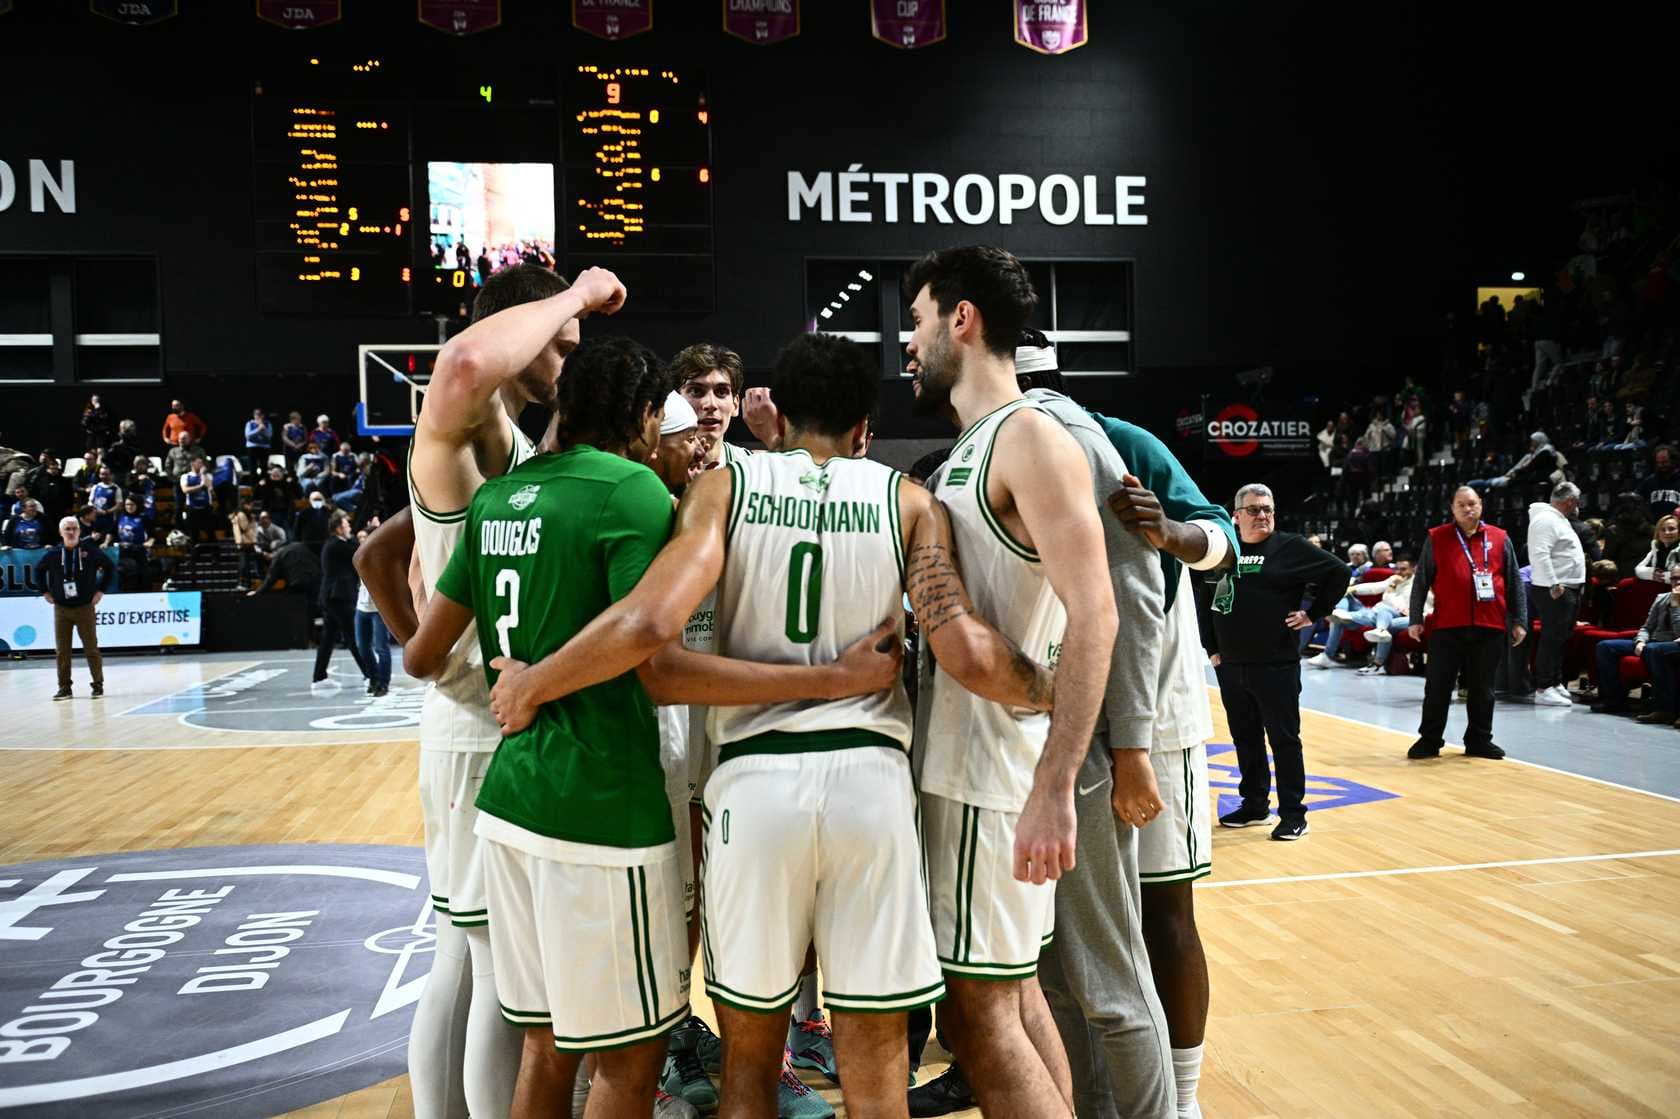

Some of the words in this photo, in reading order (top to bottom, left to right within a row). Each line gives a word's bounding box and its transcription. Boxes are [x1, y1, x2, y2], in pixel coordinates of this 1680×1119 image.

[283, 7, 314, 19] JDA
[898, 1, 918, 16] CUP
[1023, 5, 1036, 21] DE
[480, 86, 491, 103] 4
[607, 83, 620, 104] 9
[787, 163, 1148, 226] MÉTROPOLE
[1207, 421, 1311, 437] CROZATIER
[481, 517, 542, 557] DOUGLAS
[785, 541, 823, 644] 0
[119, 608, 190, 625] D'EXPERTISE
[722, 809, 730, 845] 0
[177, 910, 320, 995] DIJON
[0, 885, 236, 1064] BOURGOGNE
